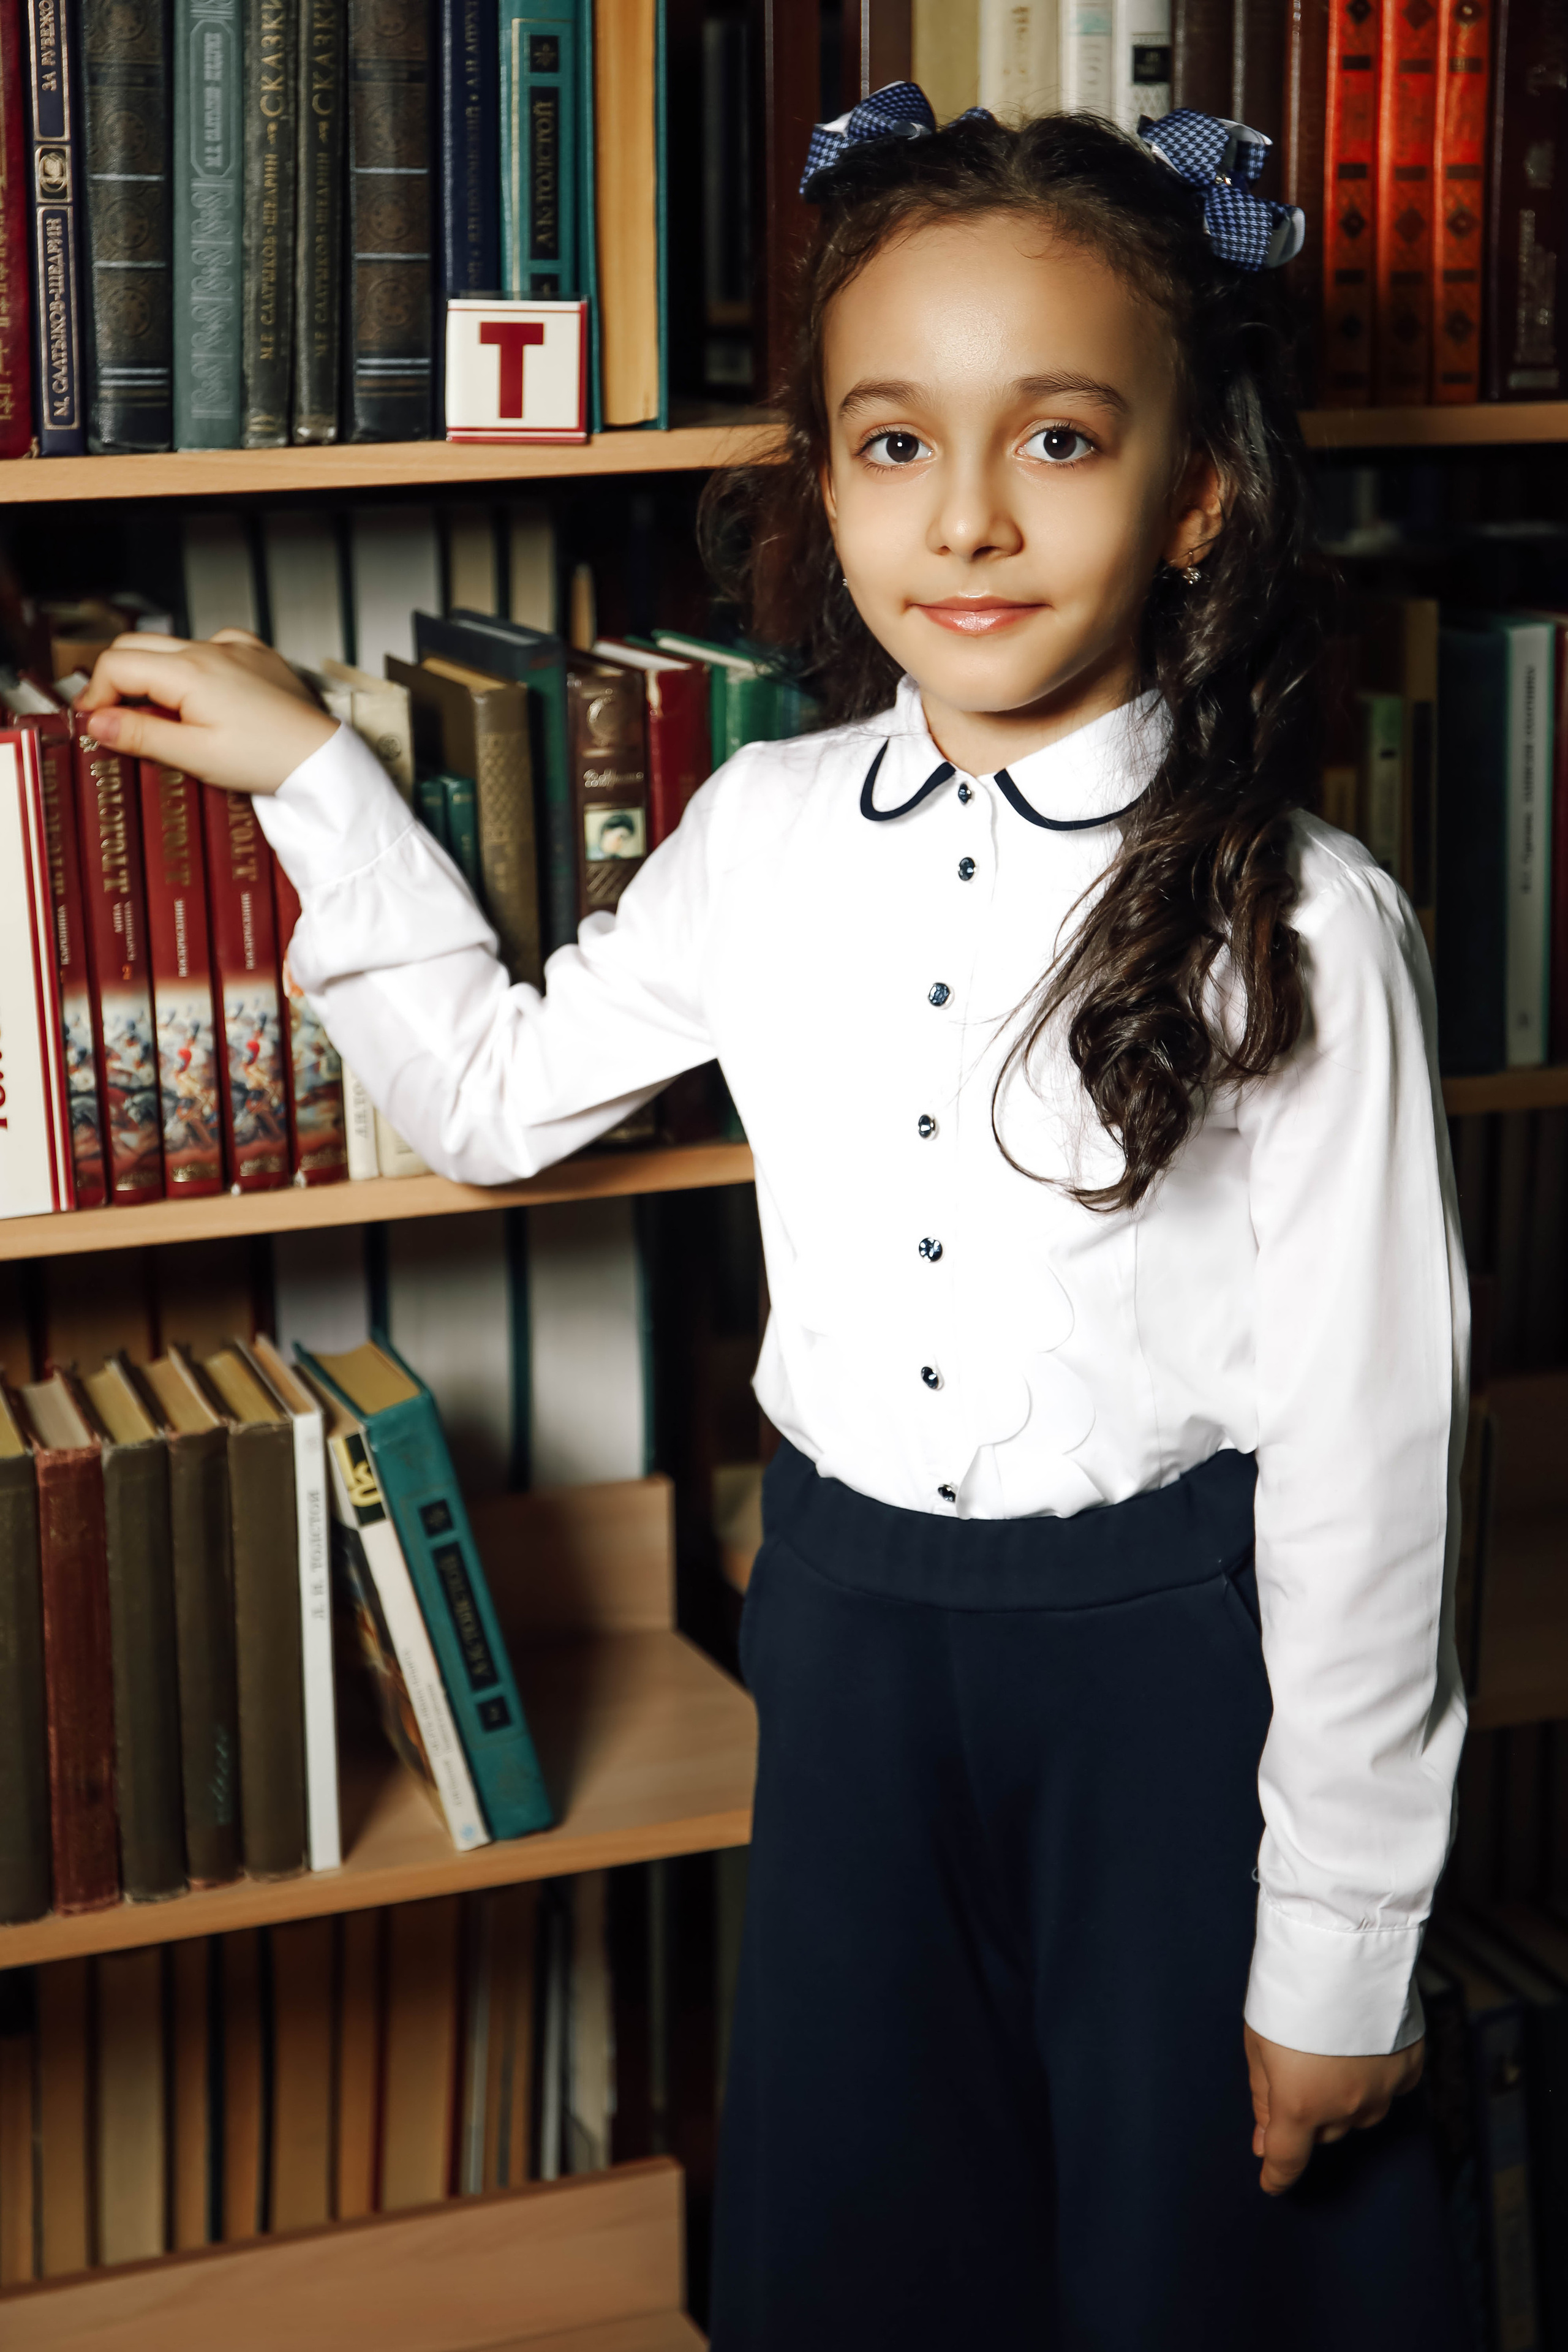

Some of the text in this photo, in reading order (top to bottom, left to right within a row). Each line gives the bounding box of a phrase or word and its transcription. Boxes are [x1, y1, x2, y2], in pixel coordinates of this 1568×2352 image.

[41, 70, 57, 91] ЗА
[46, 217, 70, 417] М. САЛТЫКОВ-ЩЕДРИН
[480, 322, 545, 419] Т
